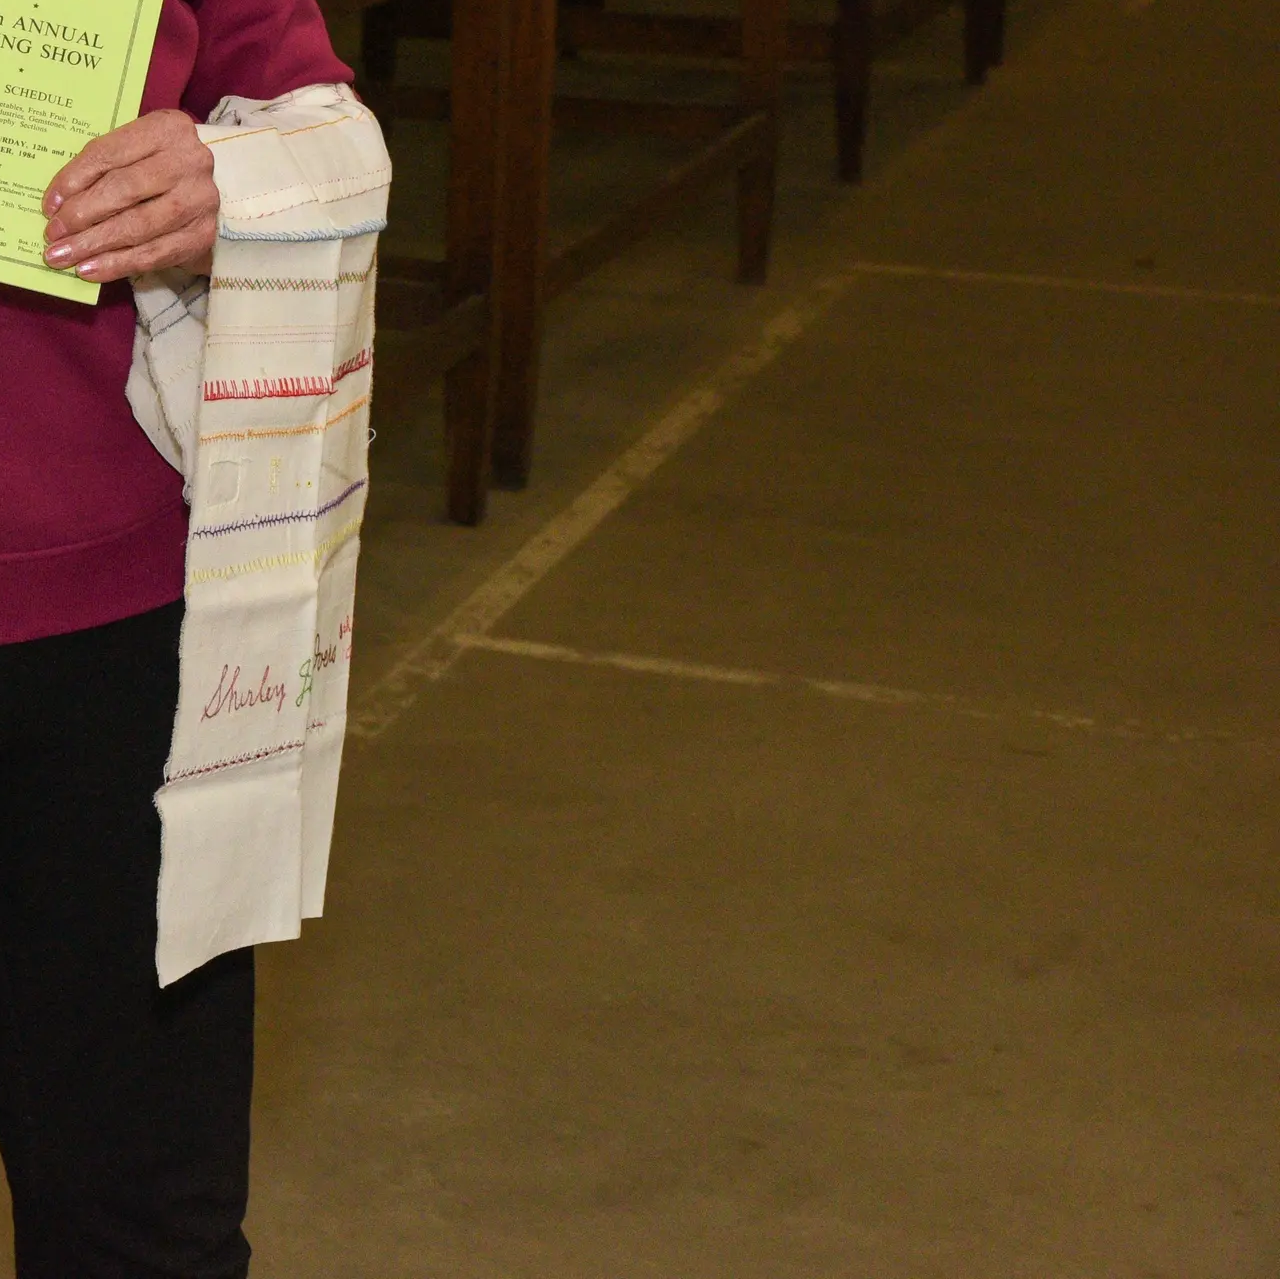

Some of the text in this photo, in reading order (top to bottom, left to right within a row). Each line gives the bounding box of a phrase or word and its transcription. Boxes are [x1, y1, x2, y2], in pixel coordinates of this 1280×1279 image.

[12, 16, 105, 50] ANNUAL
[40, 43, 102, 71] SHOW
[4, 84, 74, 109] SCHEDULE
[20, 121, 48, 133] Sections
[28, 107, 47, 117] Fresh
[49, 112, 69, 123] Fruit,
[71, 117, 92, 129] Dairy
[28, 114, 67, 131] Gemstones,
[69, 126, 86, 135] Arts
[86, 130, 100, 138] and
[18, 150, 36, 160] 1984
[32, 143, 48, 153] 12th
[51, 147, 65, 157] and
[1, 200, 15, 209] 28th
[17, 204, 43, 216] Septemb
[200, 663, 287, 722] Shirley
